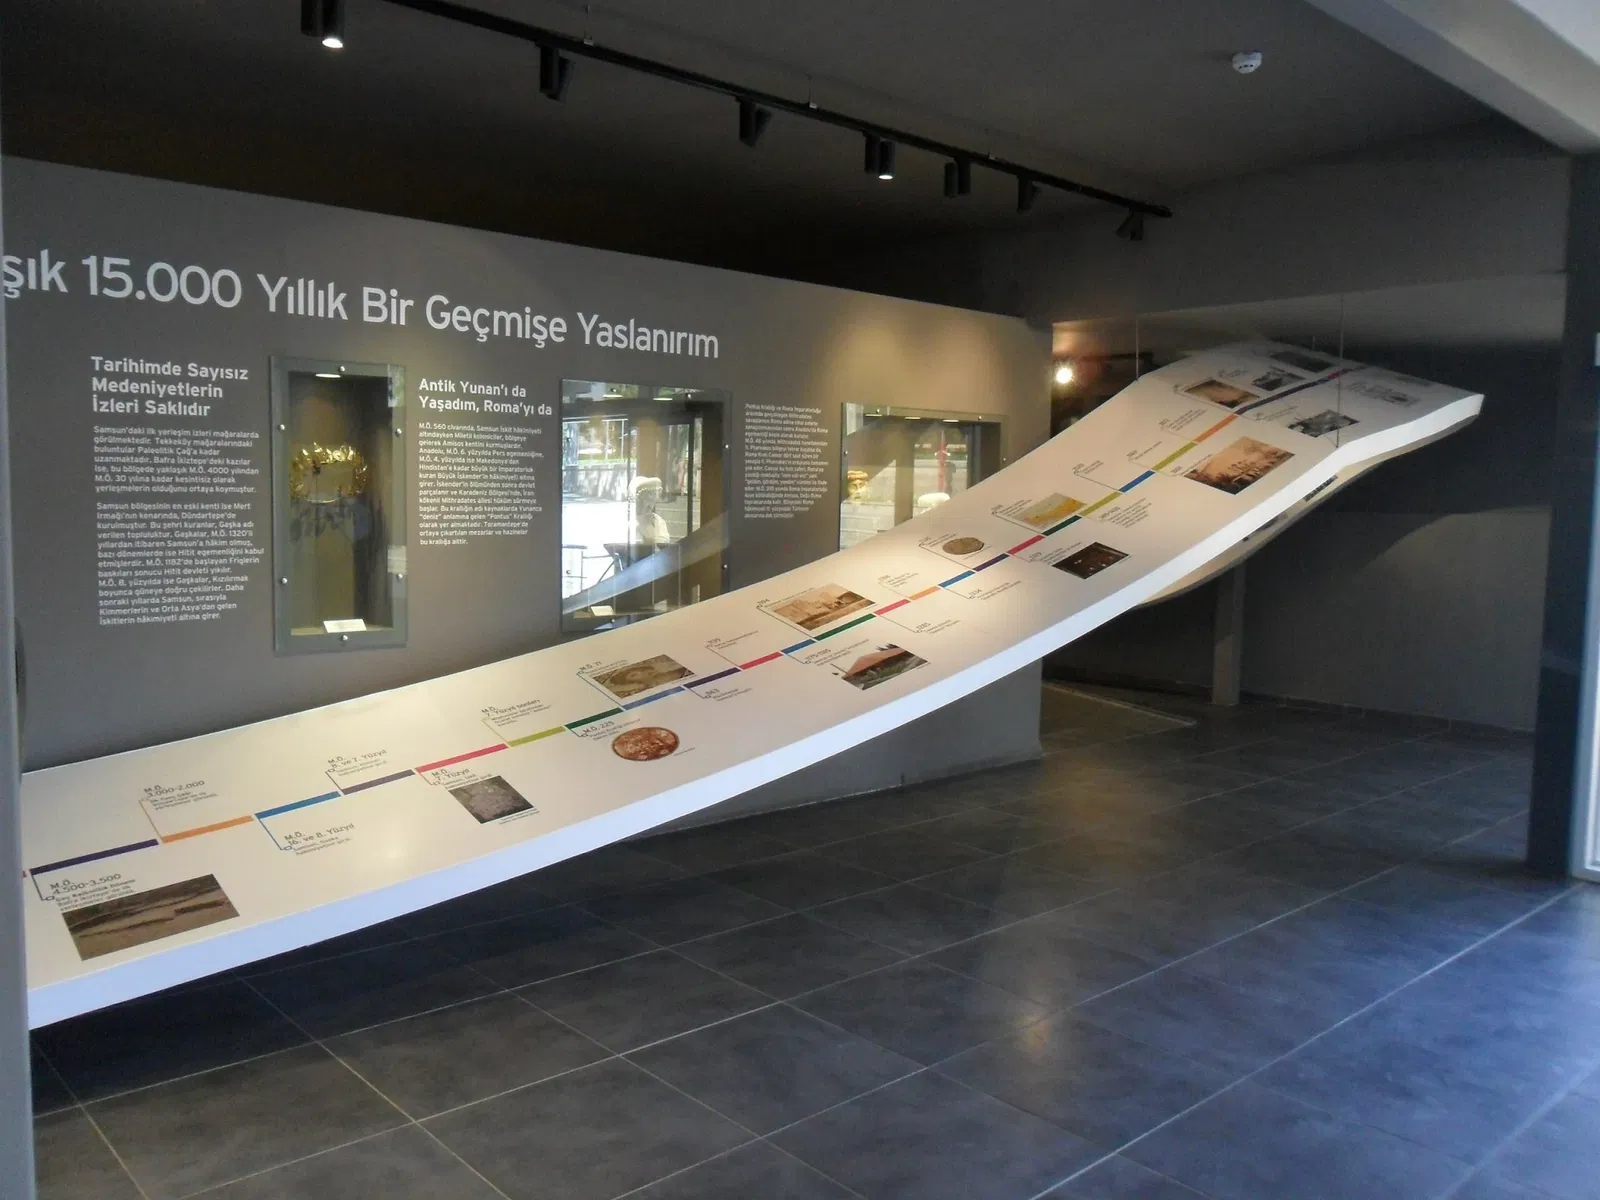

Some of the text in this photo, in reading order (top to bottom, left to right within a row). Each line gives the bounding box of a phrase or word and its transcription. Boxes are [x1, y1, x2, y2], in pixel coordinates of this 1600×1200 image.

[82, 255, 242, 308] 15.000
[257, 273, 348, 321] Yıllık
[362, 286, 414, 326] Bir
[426, 295, 568, 348] Geçmişe
[577, 312, 719, 358] Yaslanırım
[91, 356, 249, 382] Tarihimde Sayısız
[92, 377, 223, 399] Medeniyetlerin
[419, 378, 527, 397] Antik Yunan'ı da
[92, 394, 211, 417] İzleri Saklıdır
[419, 395, 552, 416] Yaşadım, Roma'yı da
